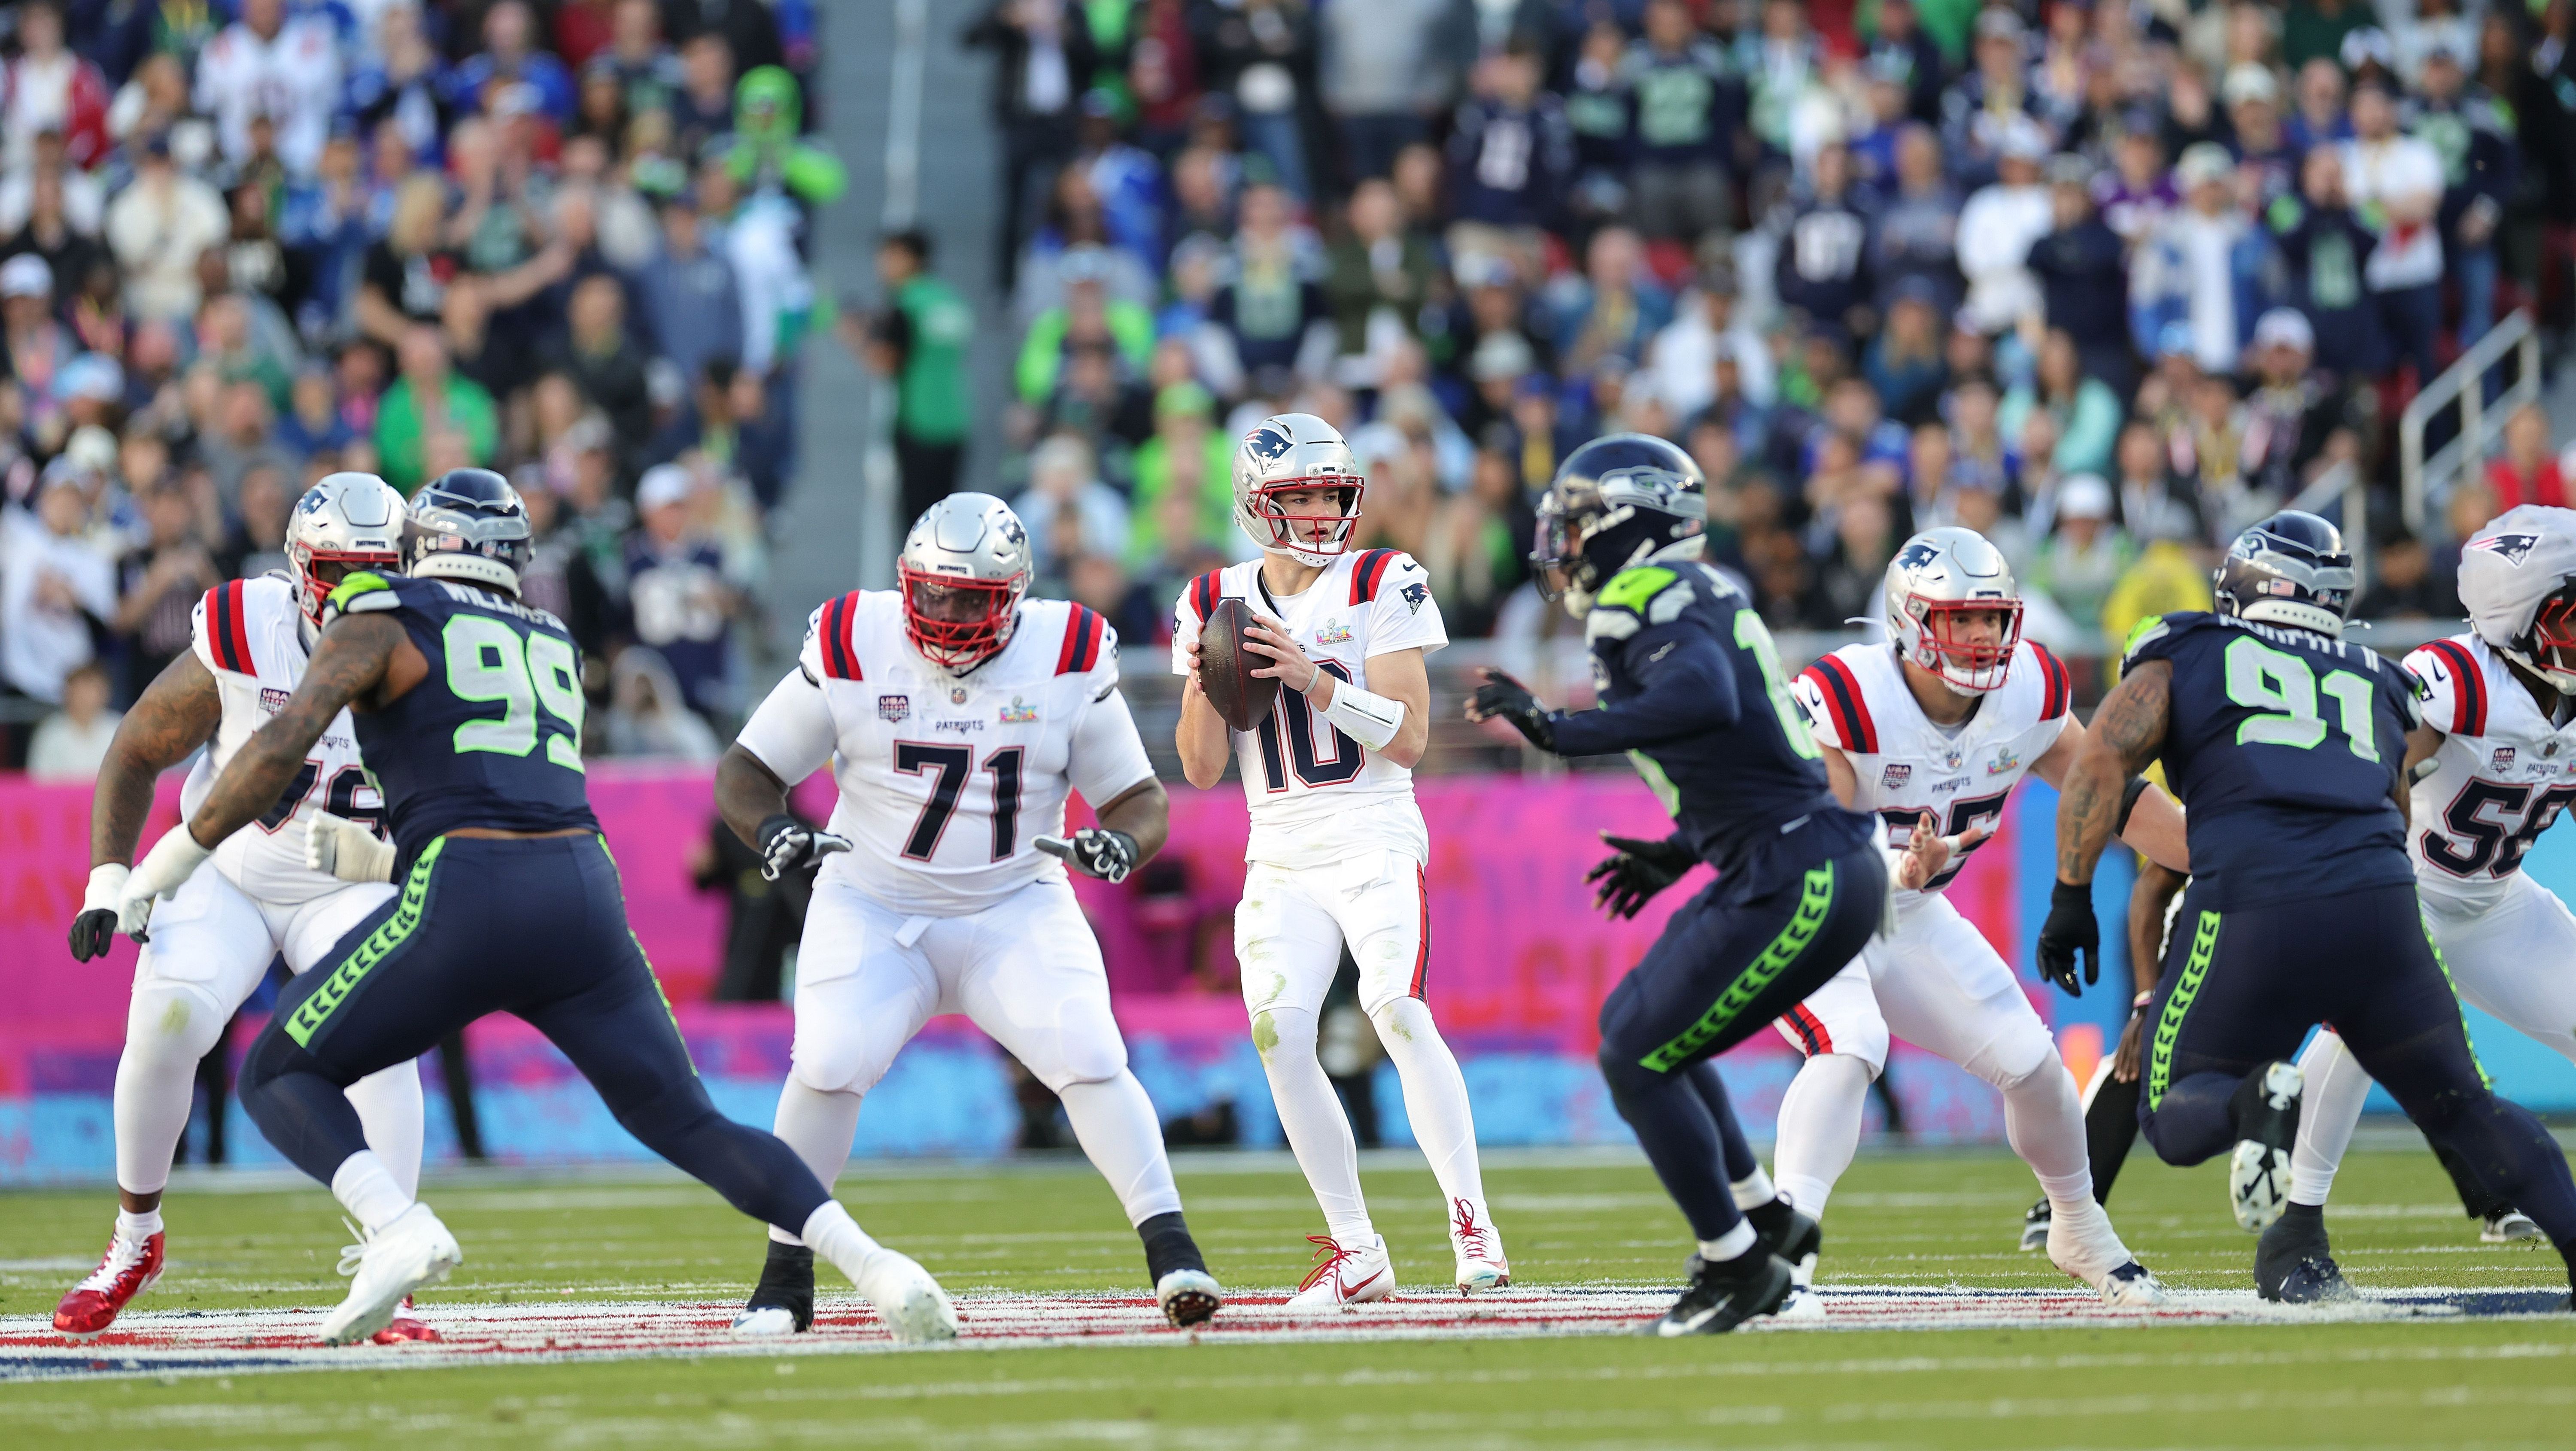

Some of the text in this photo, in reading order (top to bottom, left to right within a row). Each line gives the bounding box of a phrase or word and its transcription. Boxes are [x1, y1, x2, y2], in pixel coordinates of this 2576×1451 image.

[441, 613, 586, 774] 99
[936, 720, 984, 731] PATRIOTS
[1255, 658, 1365, 794] 10
[1733, 608, 1823, 760] 1
[2224, 634, 2380, 764] 91
[894, 739, 1025, 864] 71
[2420, 775, 2576, 880] 58
